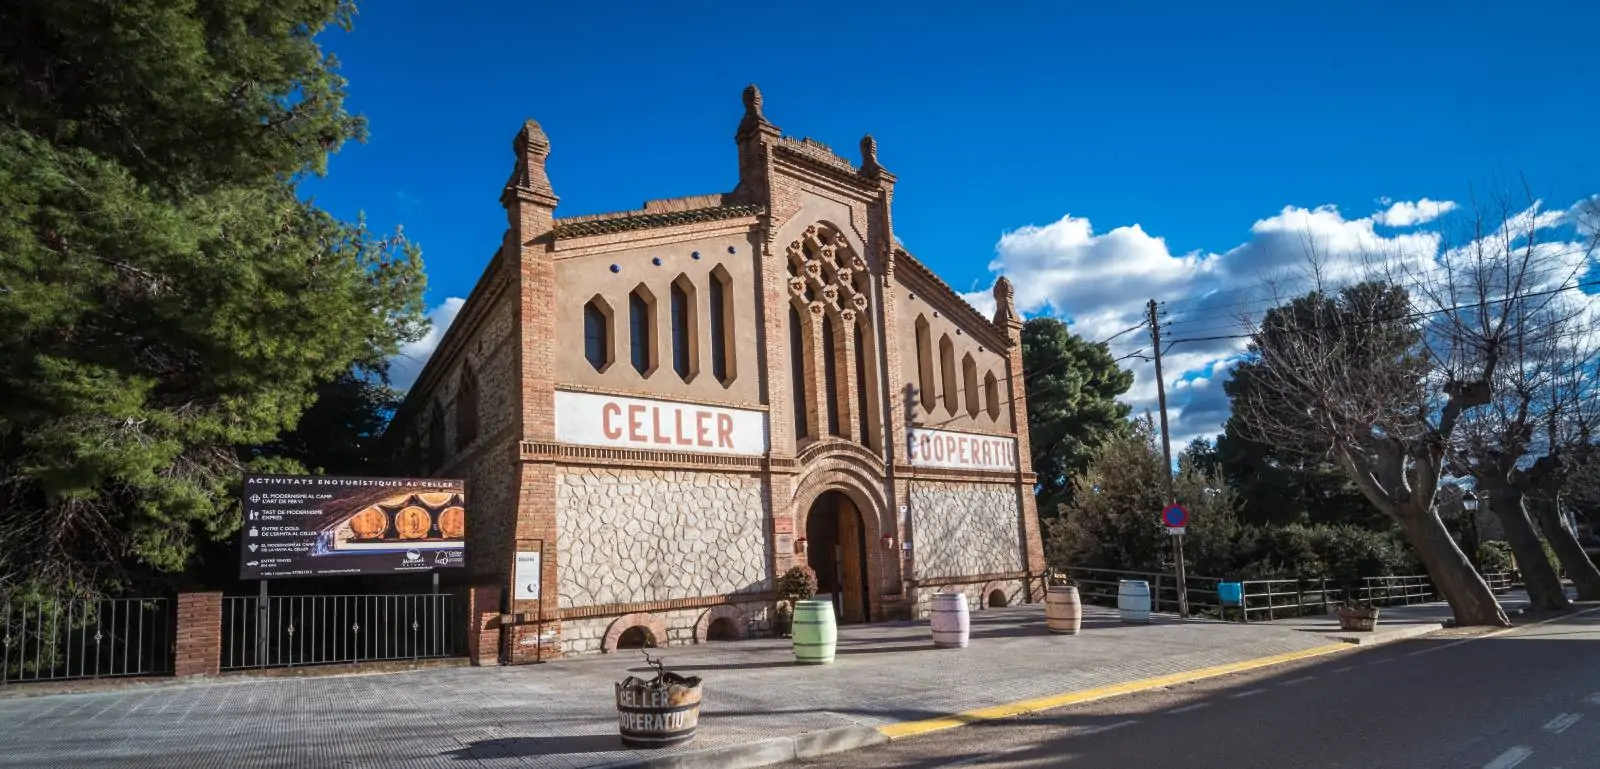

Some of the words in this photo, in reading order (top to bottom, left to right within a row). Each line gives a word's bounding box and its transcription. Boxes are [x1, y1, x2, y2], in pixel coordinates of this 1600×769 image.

[602, 402, 734, 449] CELLER
[906, 431, 1015, 467] COOPERATIU
[318, 479, 402, 487] ENOTURÍSTIQUES
[620, 711, 684, 730] OOPERATIU
